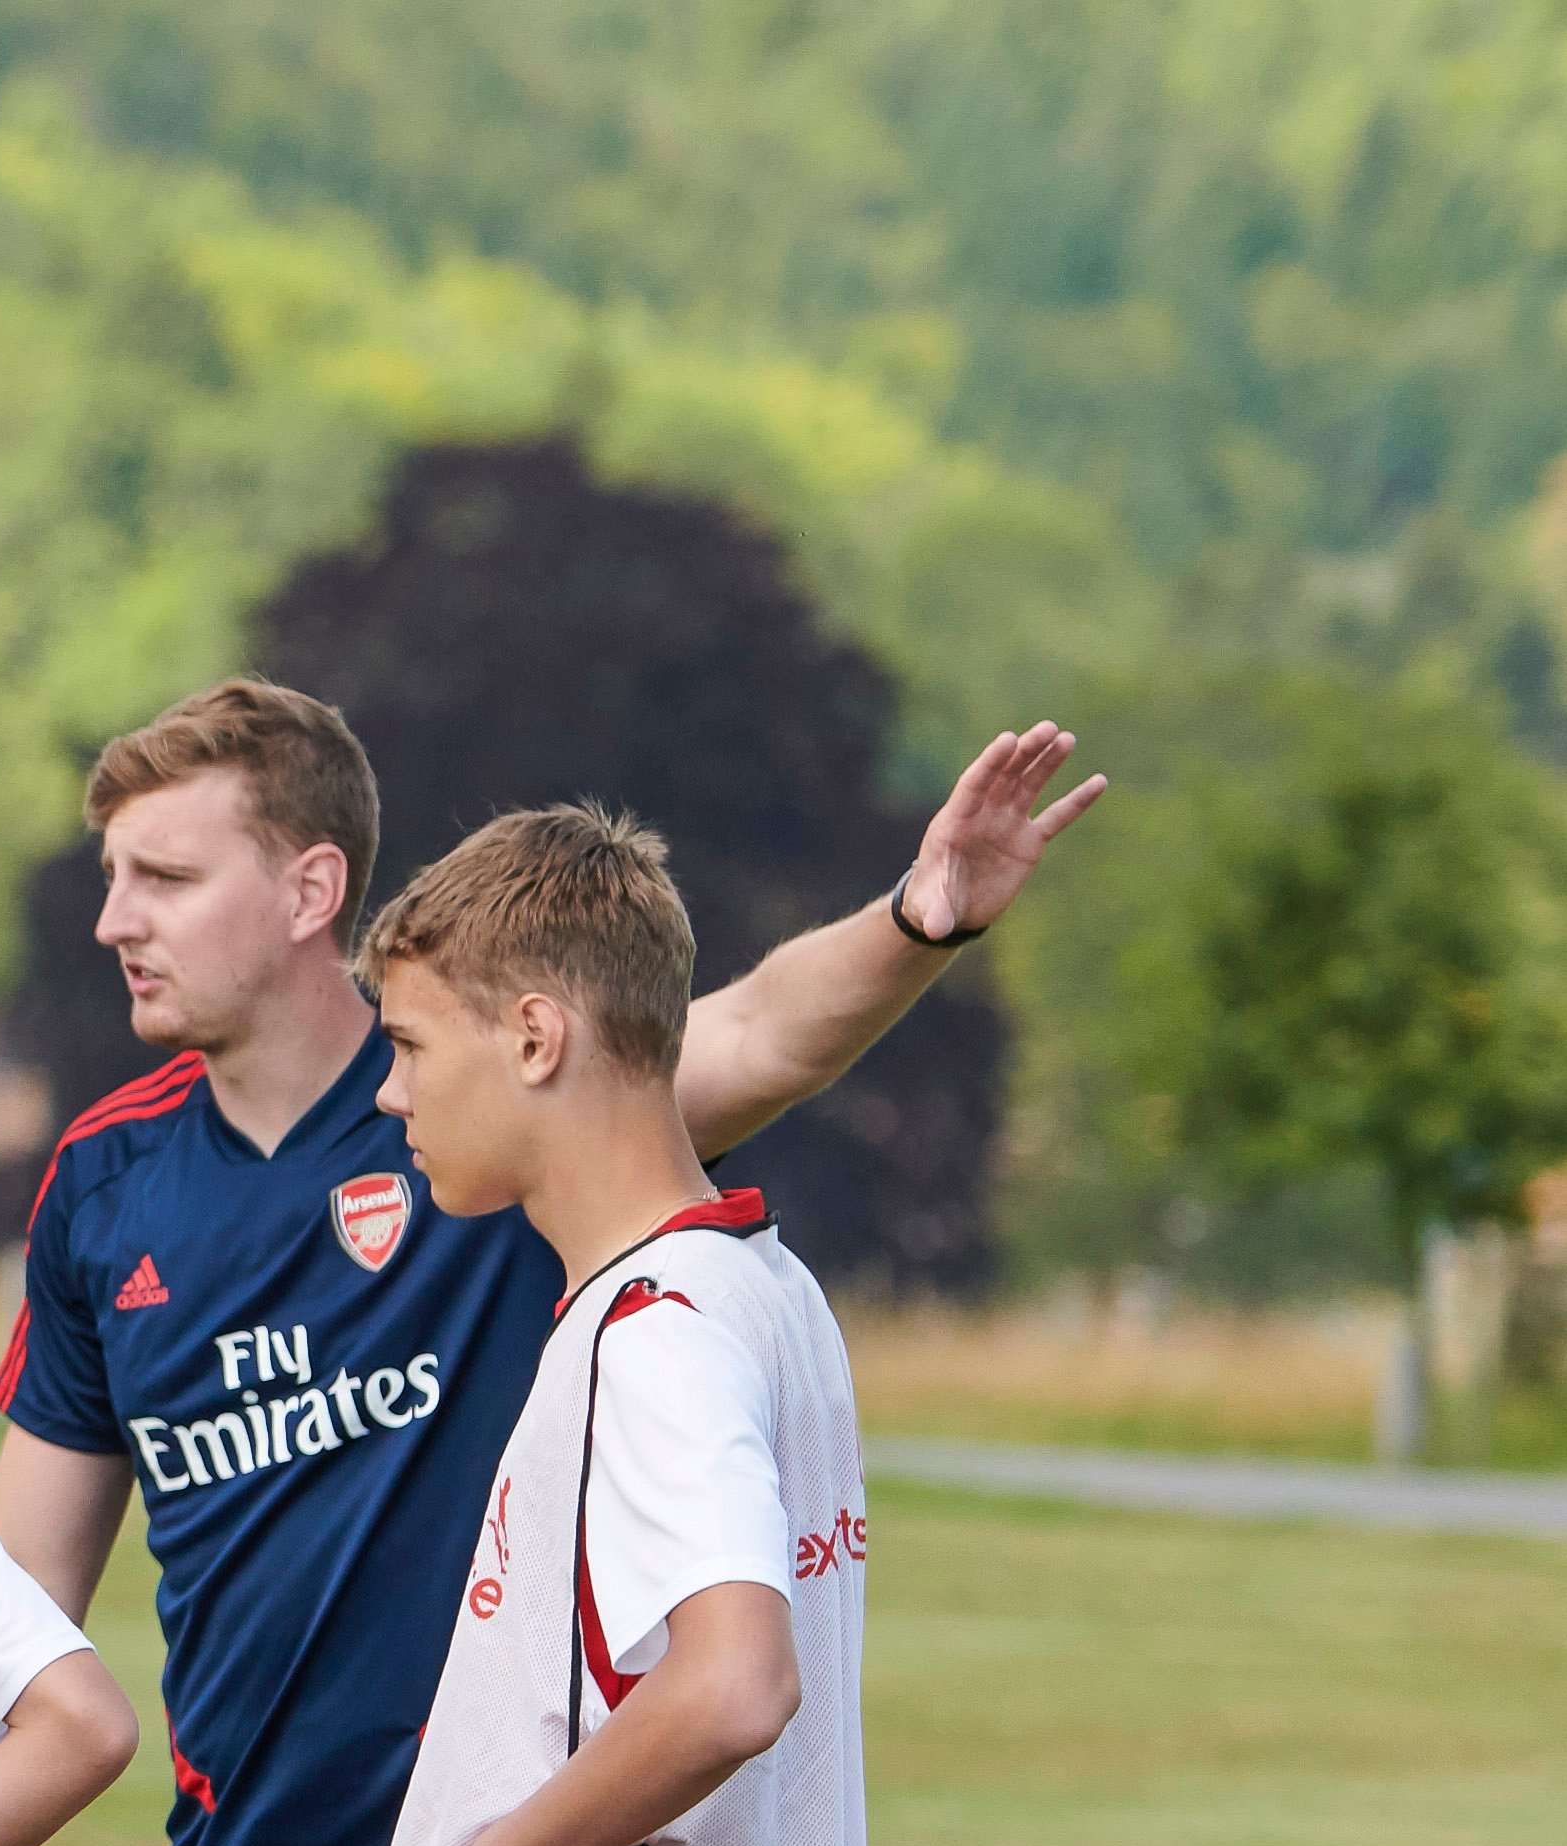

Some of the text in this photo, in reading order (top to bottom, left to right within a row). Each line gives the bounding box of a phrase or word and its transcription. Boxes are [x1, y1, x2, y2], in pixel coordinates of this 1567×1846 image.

[342, 1187, 402, 1215] Arsenal
[115, 1286, 169, 1311] adidas
[214, 1324, 312, 1390] Fly
[128, 1353, 440, 1493] Emirates
